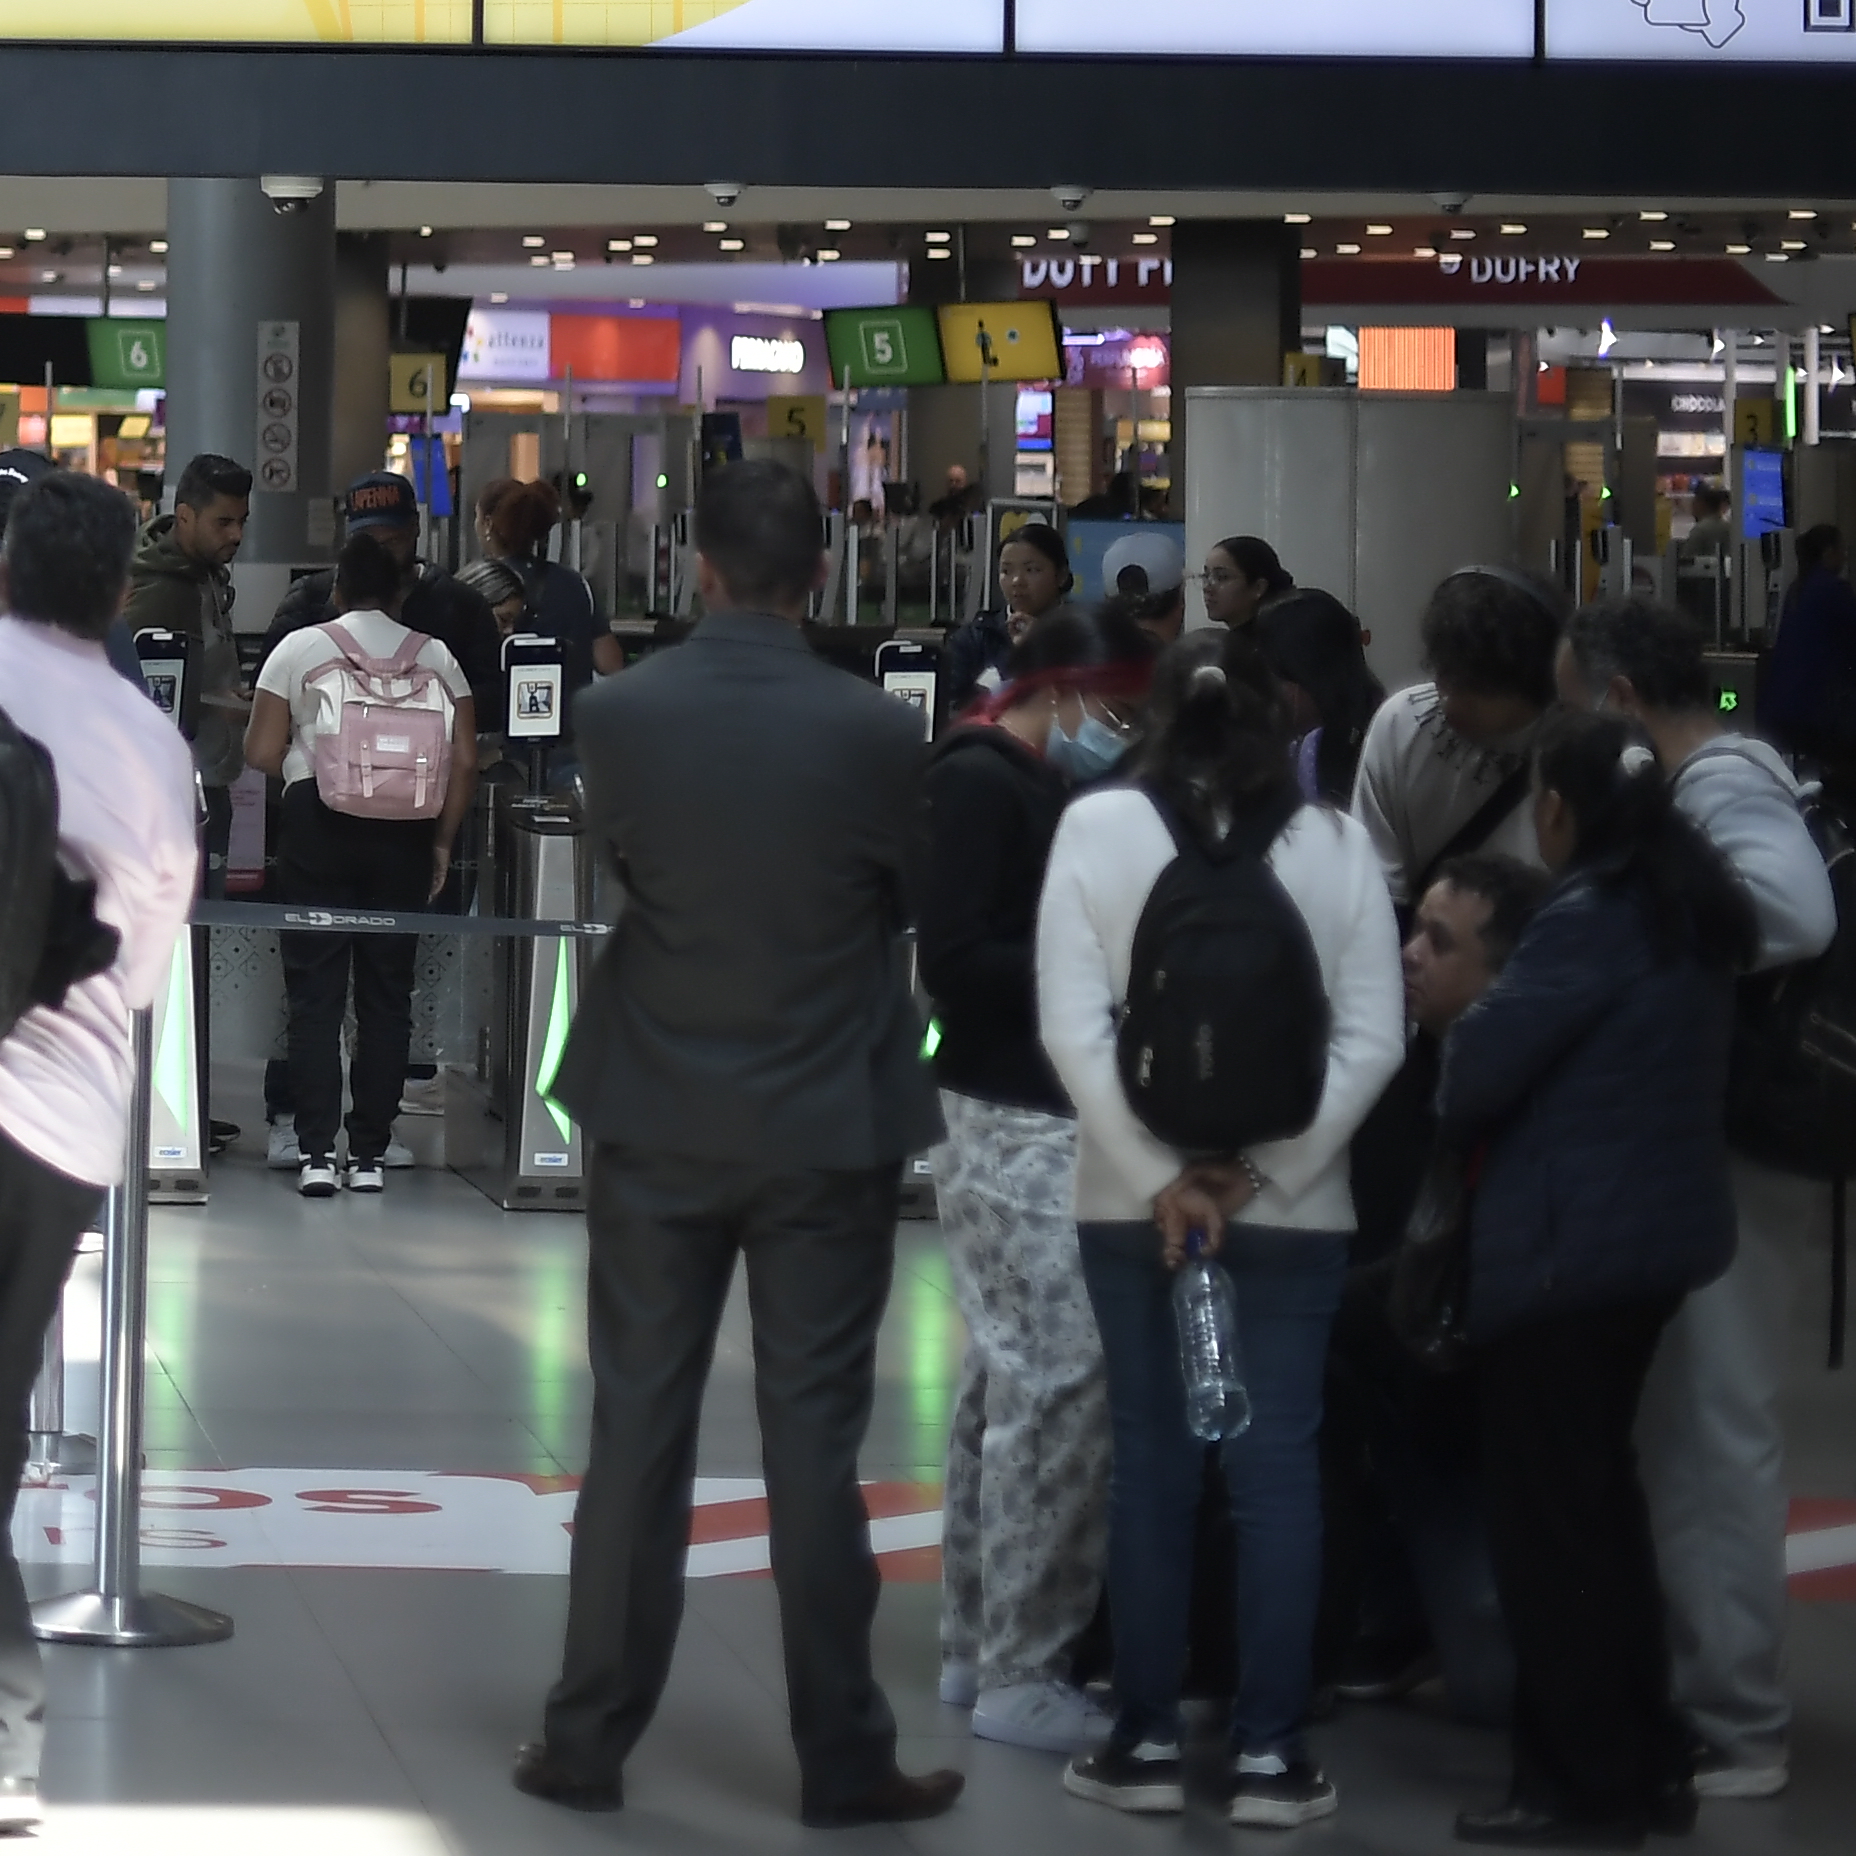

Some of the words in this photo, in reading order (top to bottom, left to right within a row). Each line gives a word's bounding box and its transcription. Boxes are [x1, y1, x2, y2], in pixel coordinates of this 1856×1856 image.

[130, 340, 148, 369] 6
[873, 332, 893, 363] 5
[408, 368, 428, 398] 6
[789, 407, 806, 436] 5
[285, 912, 308, 923] EL
[309, 911, 396, 927] DORADO
